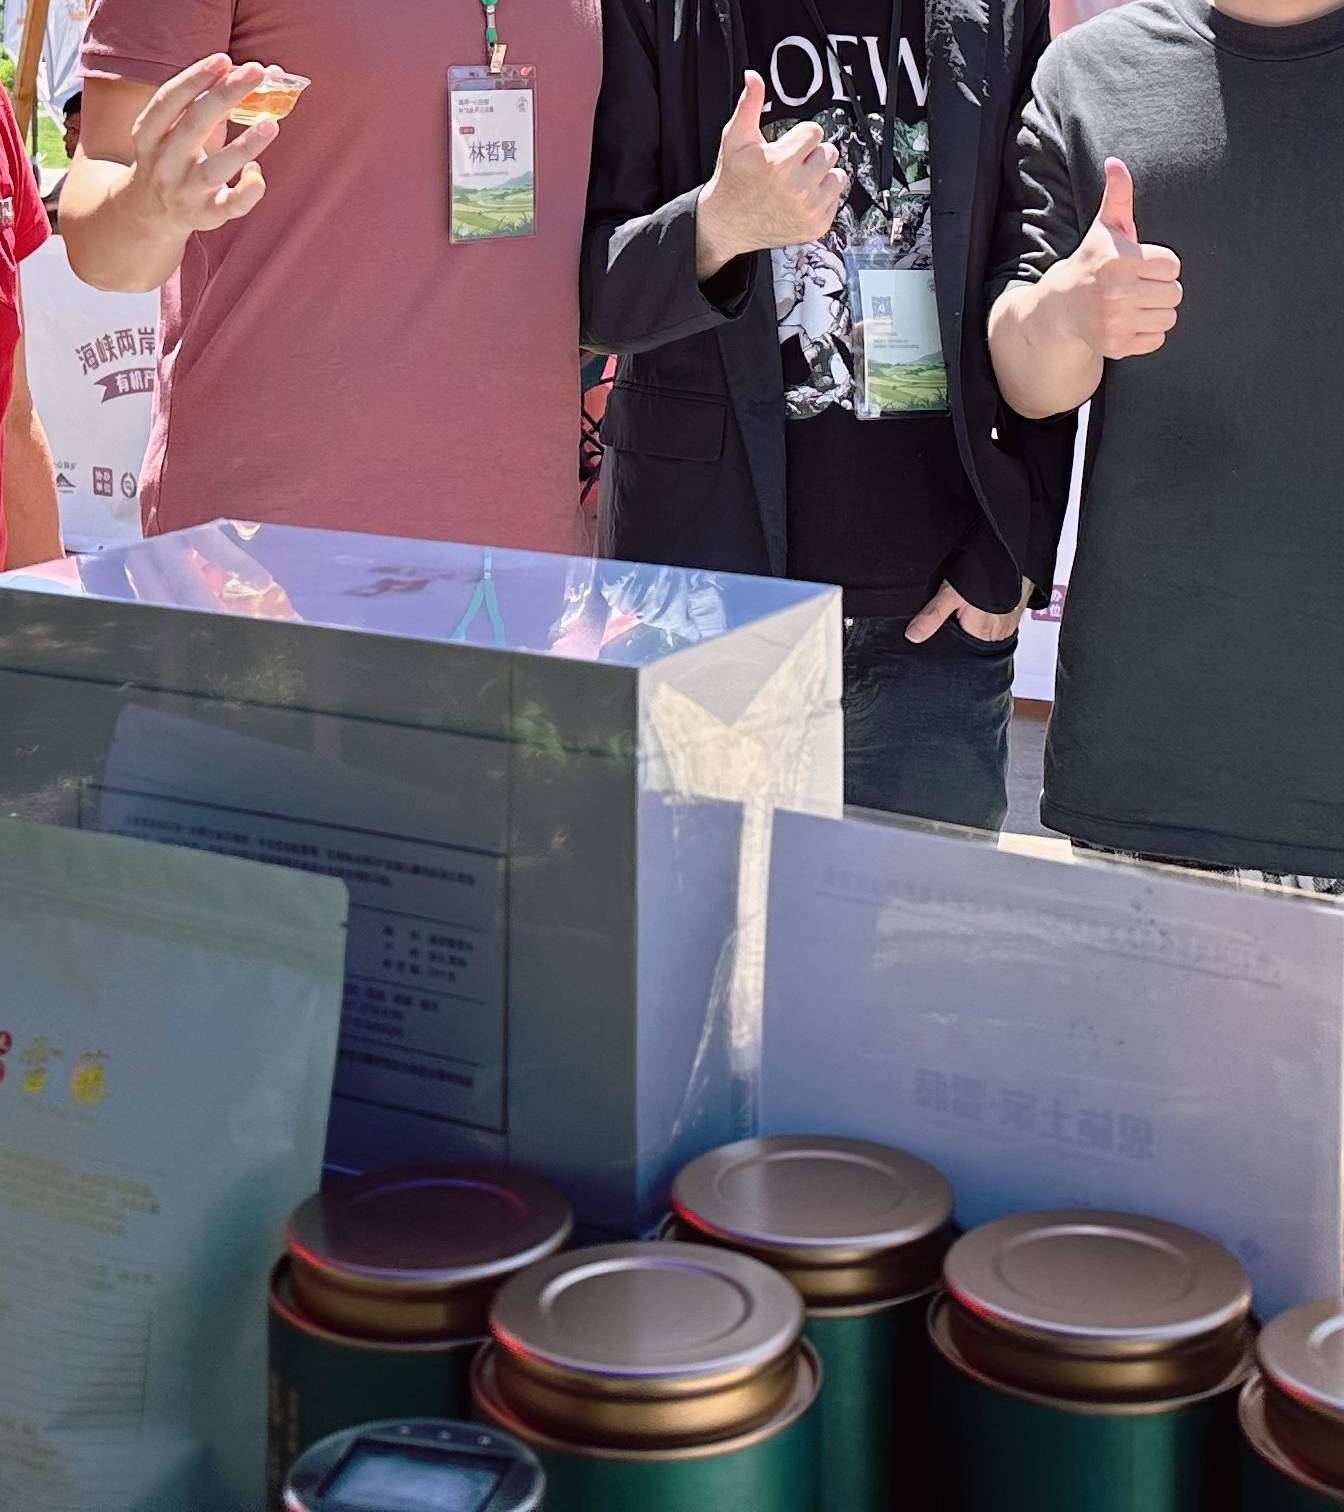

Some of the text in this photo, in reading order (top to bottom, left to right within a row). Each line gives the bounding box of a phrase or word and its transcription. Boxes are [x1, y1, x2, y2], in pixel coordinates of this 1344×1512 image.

[761, 34, 929, 114] OEW
[75, 326, 156, 376] 海峡两岸
